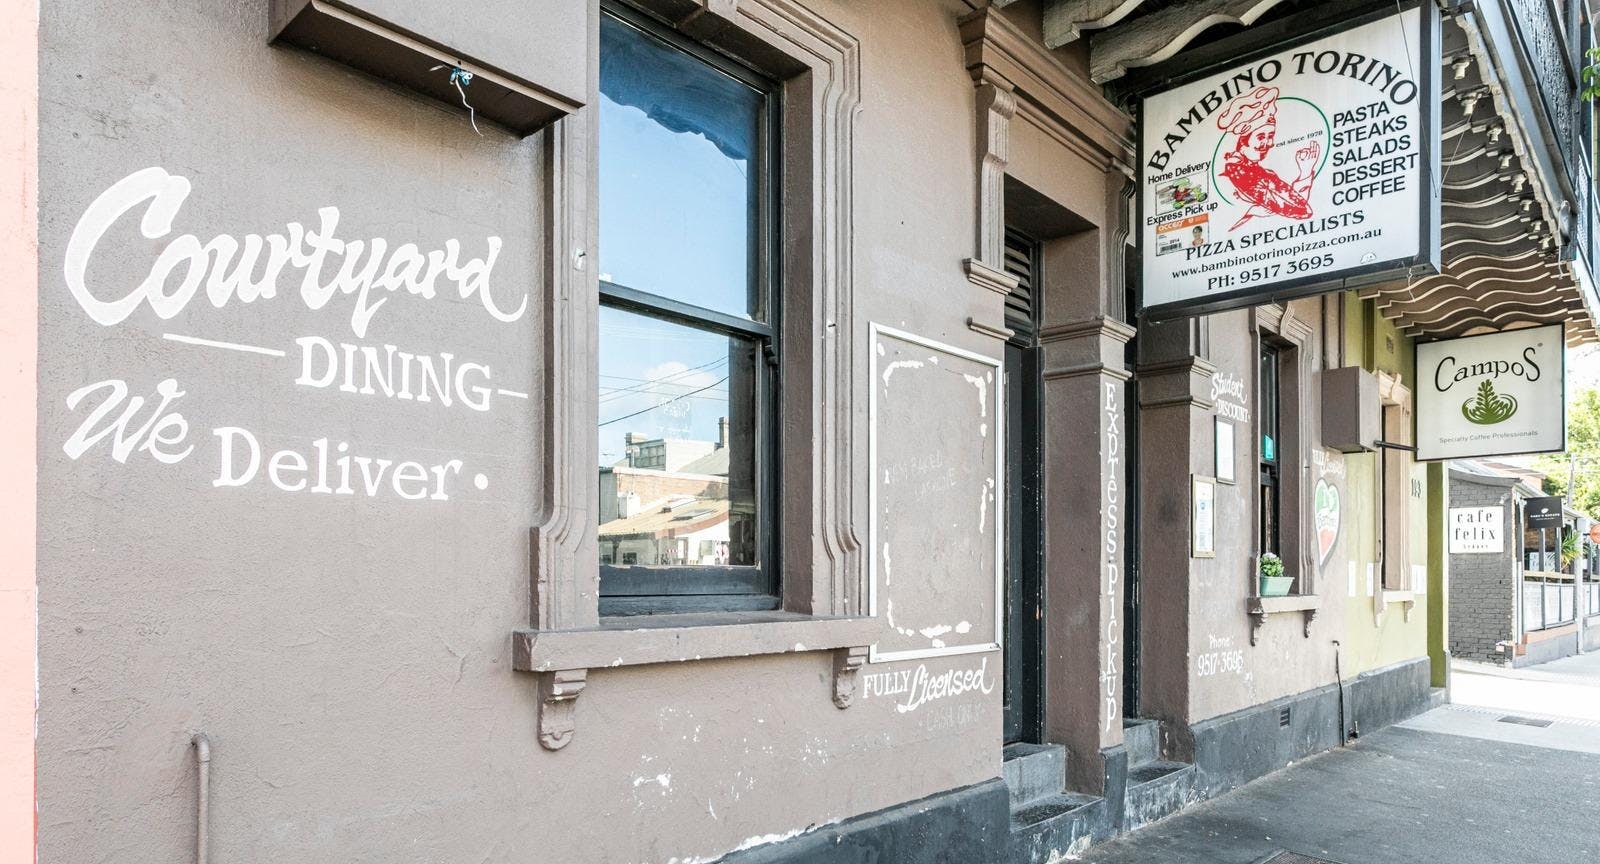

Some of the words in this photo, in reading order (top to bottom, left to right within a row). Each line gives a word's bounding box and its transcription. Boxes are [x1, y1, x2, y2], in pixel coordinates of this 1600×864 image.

[1147, 60, 1281, 173] BAMBINO
[1292, 50, 1418, 107] TORINO
[1333, 101, 1390, 129] PASTA
[1333, 116, 1408, 148] STEAKS
[1333, 135, 1411, 168] SALADS
[1148, 172, 1173, 185] Home
[1175, 160, 1211, 177] Delivery
[1333, 153, 1419, 187] DESSERT
[1332, 175, 1405, 207] COFFEE
[1147, 211, 1183, 226] Express
[1184, 204, 1204, 217] Pick
[1206, 202, 1219, 212] up
[1185, 240, 1237, 261] PIZZA
[1240, 210, 1366, 249] SPECIALISTS
[64, 166, 528, 339] Courtyard
[1172, 227, 1382, 280] www.bambinotorinopizza.com.au
[1207, 275, 1236, 291] PH:
[1240, 265, 1281, 285] 9517
[1287, 253, 1335, 274] 3695
[294, 336, 492, 411] DINING
[1211, 372, 1248, 404] Student
[63, 378, 195, 464] We
[212, 426, 464, 501] Deliver
[1470, 433, 1491, 441] Coffee
[1492, 430, 1538, 440] Professionals
[1457, 510, 1492, 523] cafe
[1456, 527, 1495, 540] felix
[862, 671, 911, 699] FULLY
[896, 656, 995, 714] Licensed
